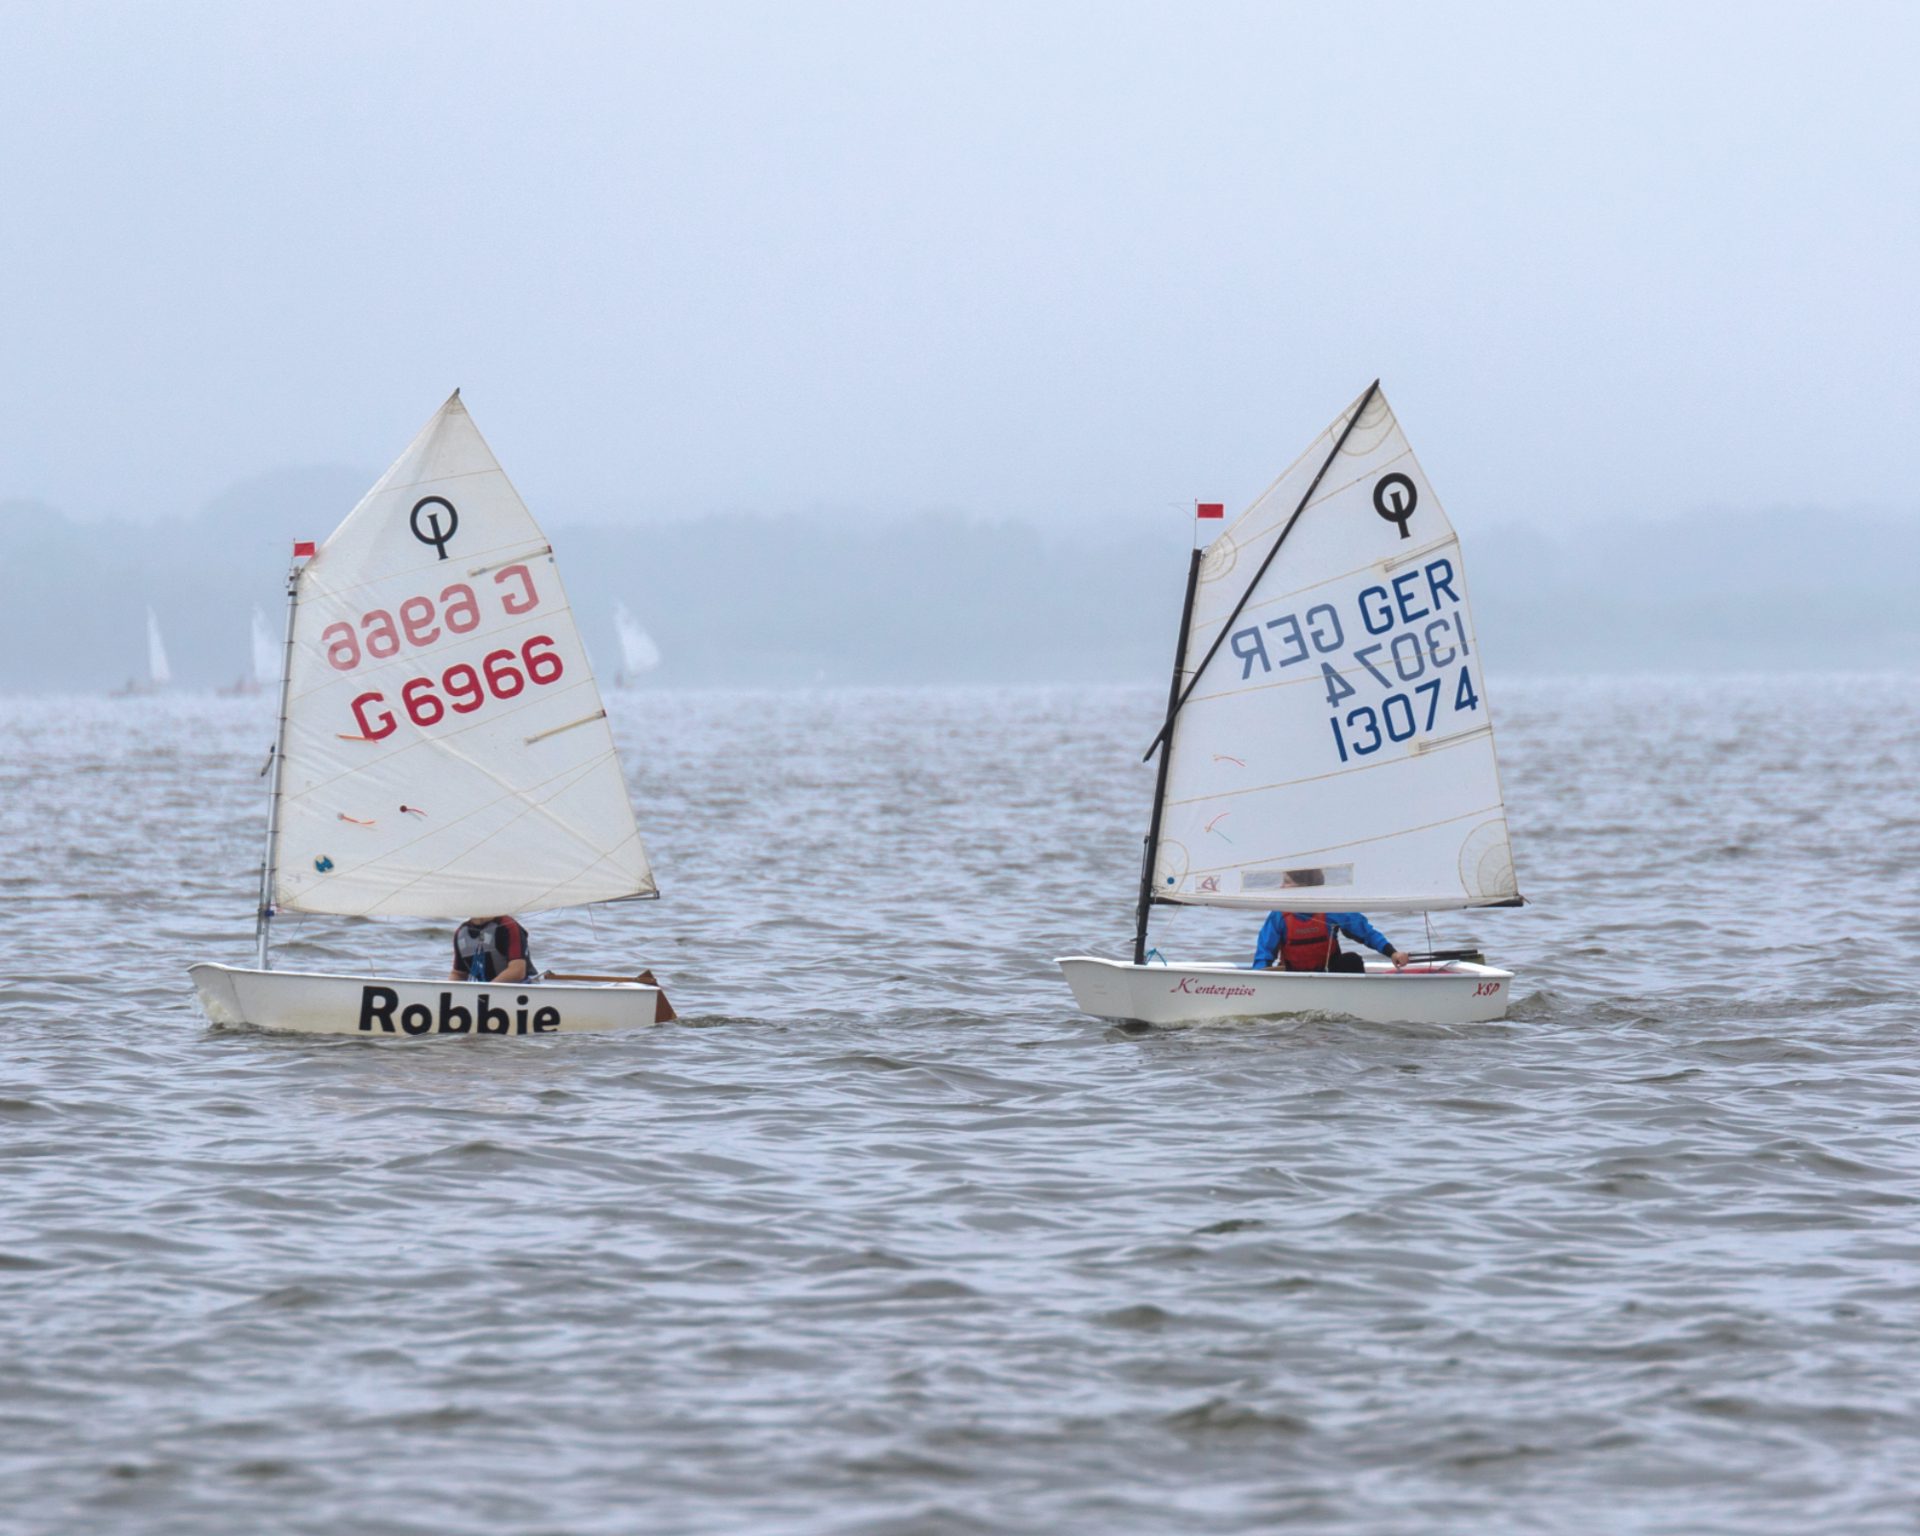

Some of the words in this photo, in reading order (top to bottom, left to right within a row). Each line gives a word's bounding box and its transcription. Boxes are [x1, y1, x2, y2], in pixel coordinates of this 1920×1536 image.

[1357, 558, 1460, 635] GER
[1329, 665, 1479, 762] 13074
[358, 985, 561, 1035] Robbie
